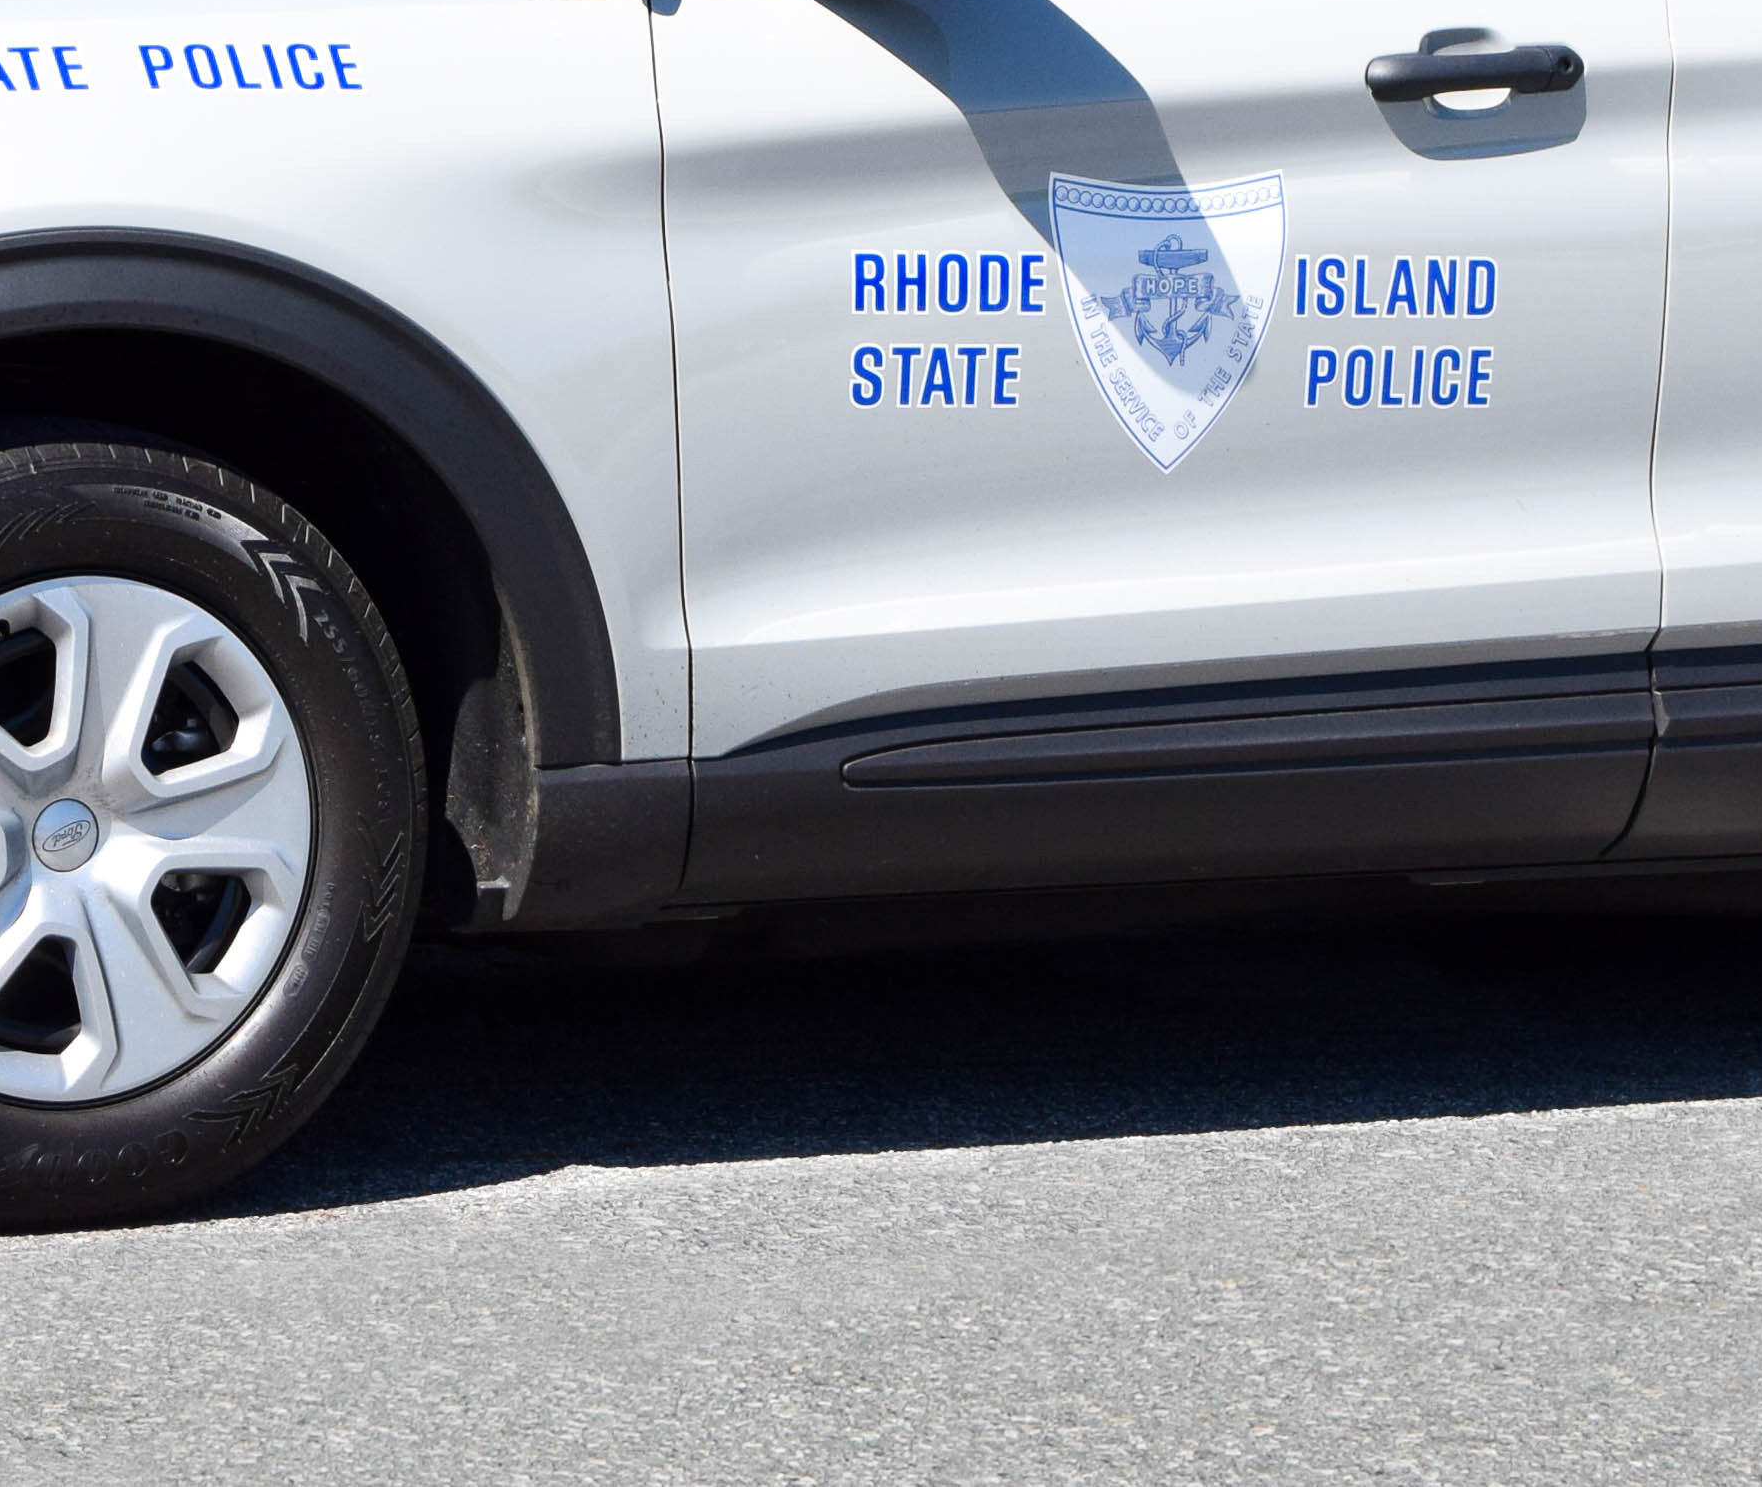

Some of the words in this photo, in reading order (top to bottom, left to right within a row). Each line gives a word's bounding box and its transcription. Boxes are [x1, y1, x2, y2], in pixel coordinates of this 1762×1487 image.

[139, 44, 361, 89] POLICE
[855, 254, 1043, 312] RHODE
[1298, 258, 1495, 315] ISLAND
[1144, 278, 1200, 295] HOPE
[852, 347, 1018, 405] STATE
[1308, 349, 1490, 405] POLICE
[1080, 293, 1099, 320] IN
[1091, 324, 1118, 368] THE
[1109, 367, 1165, 442] SERVICE
[1174, 410, 1198, 440] OF
[1198, 366, 1232, 408] THE
[1228, 295, 1264, 363] STATE
